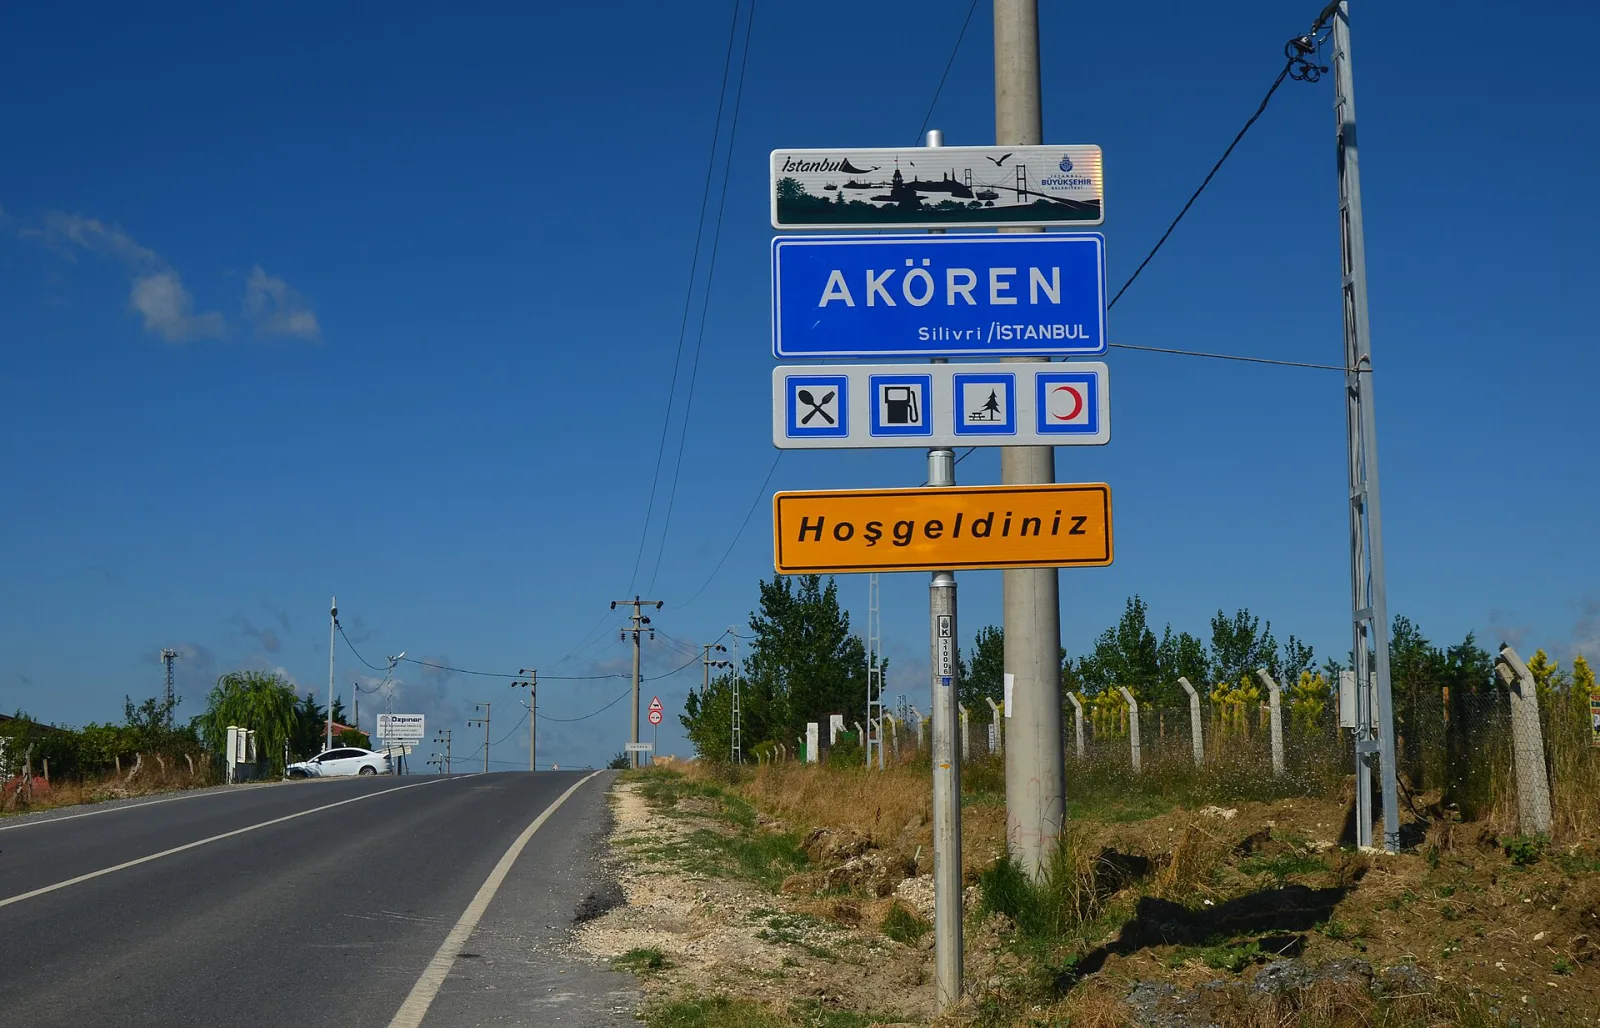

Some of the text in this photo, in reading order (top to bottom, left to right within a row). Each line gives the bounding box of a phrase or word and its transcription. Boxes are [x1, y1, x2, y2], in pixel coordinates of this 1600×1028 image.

[781, 155, 847, 173] İstanbul
[1041, 177, 1092, 187] BÜYÜKŞEHİR
[818, 258, 1061, 308] AKÖREN
[918, 326, 982, 341] Silivri
[797, 510, 1088, 547] Hoşgeldiniz
